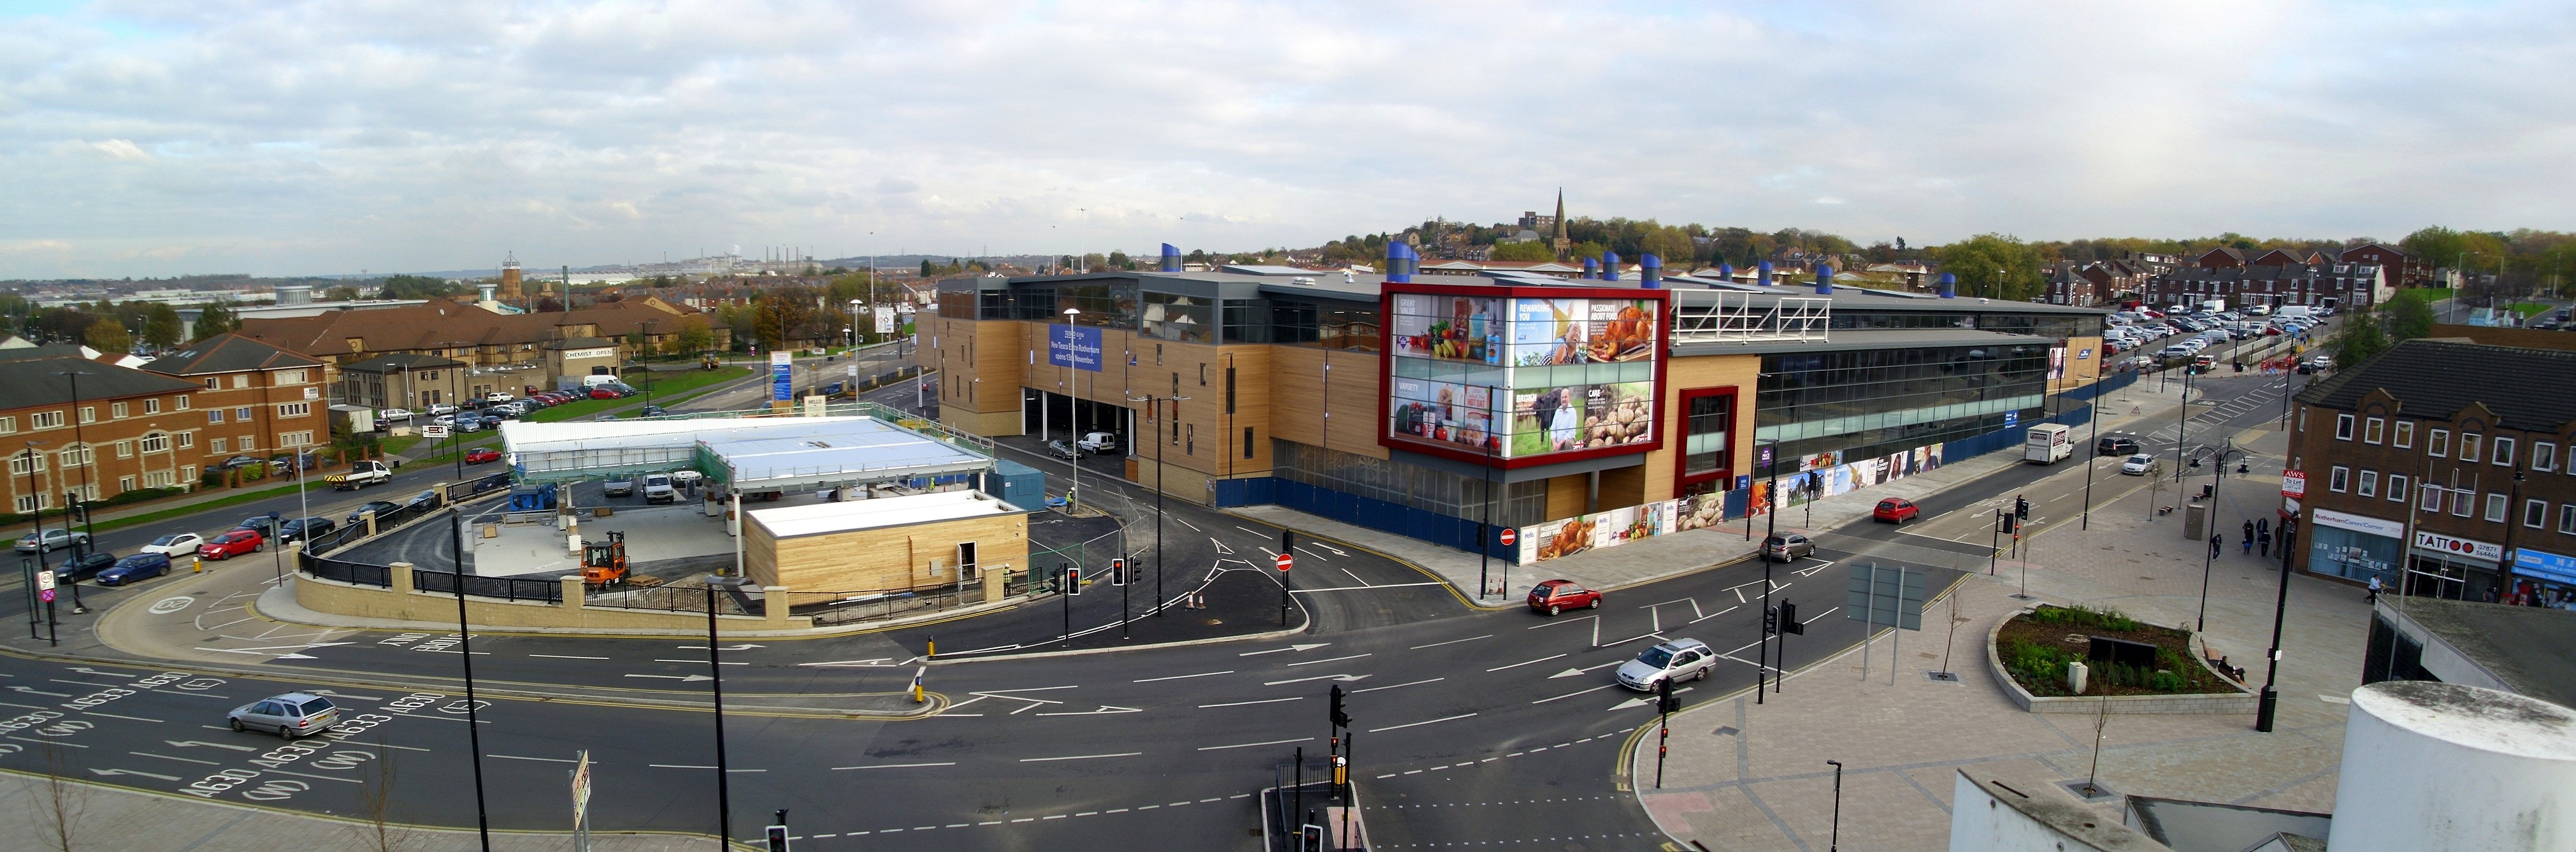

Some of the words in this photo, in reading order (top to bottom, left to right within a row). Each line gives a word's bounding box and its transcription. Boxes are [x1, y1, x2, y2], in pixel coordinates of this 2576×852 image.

[1400, 307, 1415, 315] VALUE
[1519, 304, 1550, 312] REWARDING
[1591, 304, 1615, 312] PASSIONATE
[1519, 312, 1530, 321] YOU
[1590, 312, 1606, 321] ABOUT
[1606, 312, 1618, 321] FOOD
[1058, 342, 1069, 350] Tesco
[1069, 343, 1078, 351] Etra
[1078, 344, 1100, 354] Rotherham
[1399, 382, 1419, 392] VARIETY
[1516, 393, 1537, 403] BRITISH
[1588, 389, 1601, 398] CARE
[2419, 533, 2474, 554] TATTOO
[2475, 550, 2498, 559] 564466
[128, 672, 192, 689] A630
[176, 679, 227, 690] (E)
[61, 688, 137, 711] A633
[380, 691, 445, 714] A630
[36, 721, 95, 736] (W)
[319, 713, 392, 740] A633
[248, 739, 330, 769] A630
[310, 750, 376, 770] (W)
[178, 769, 261, 798] A630
[241, 779, 310, 800] (W)
